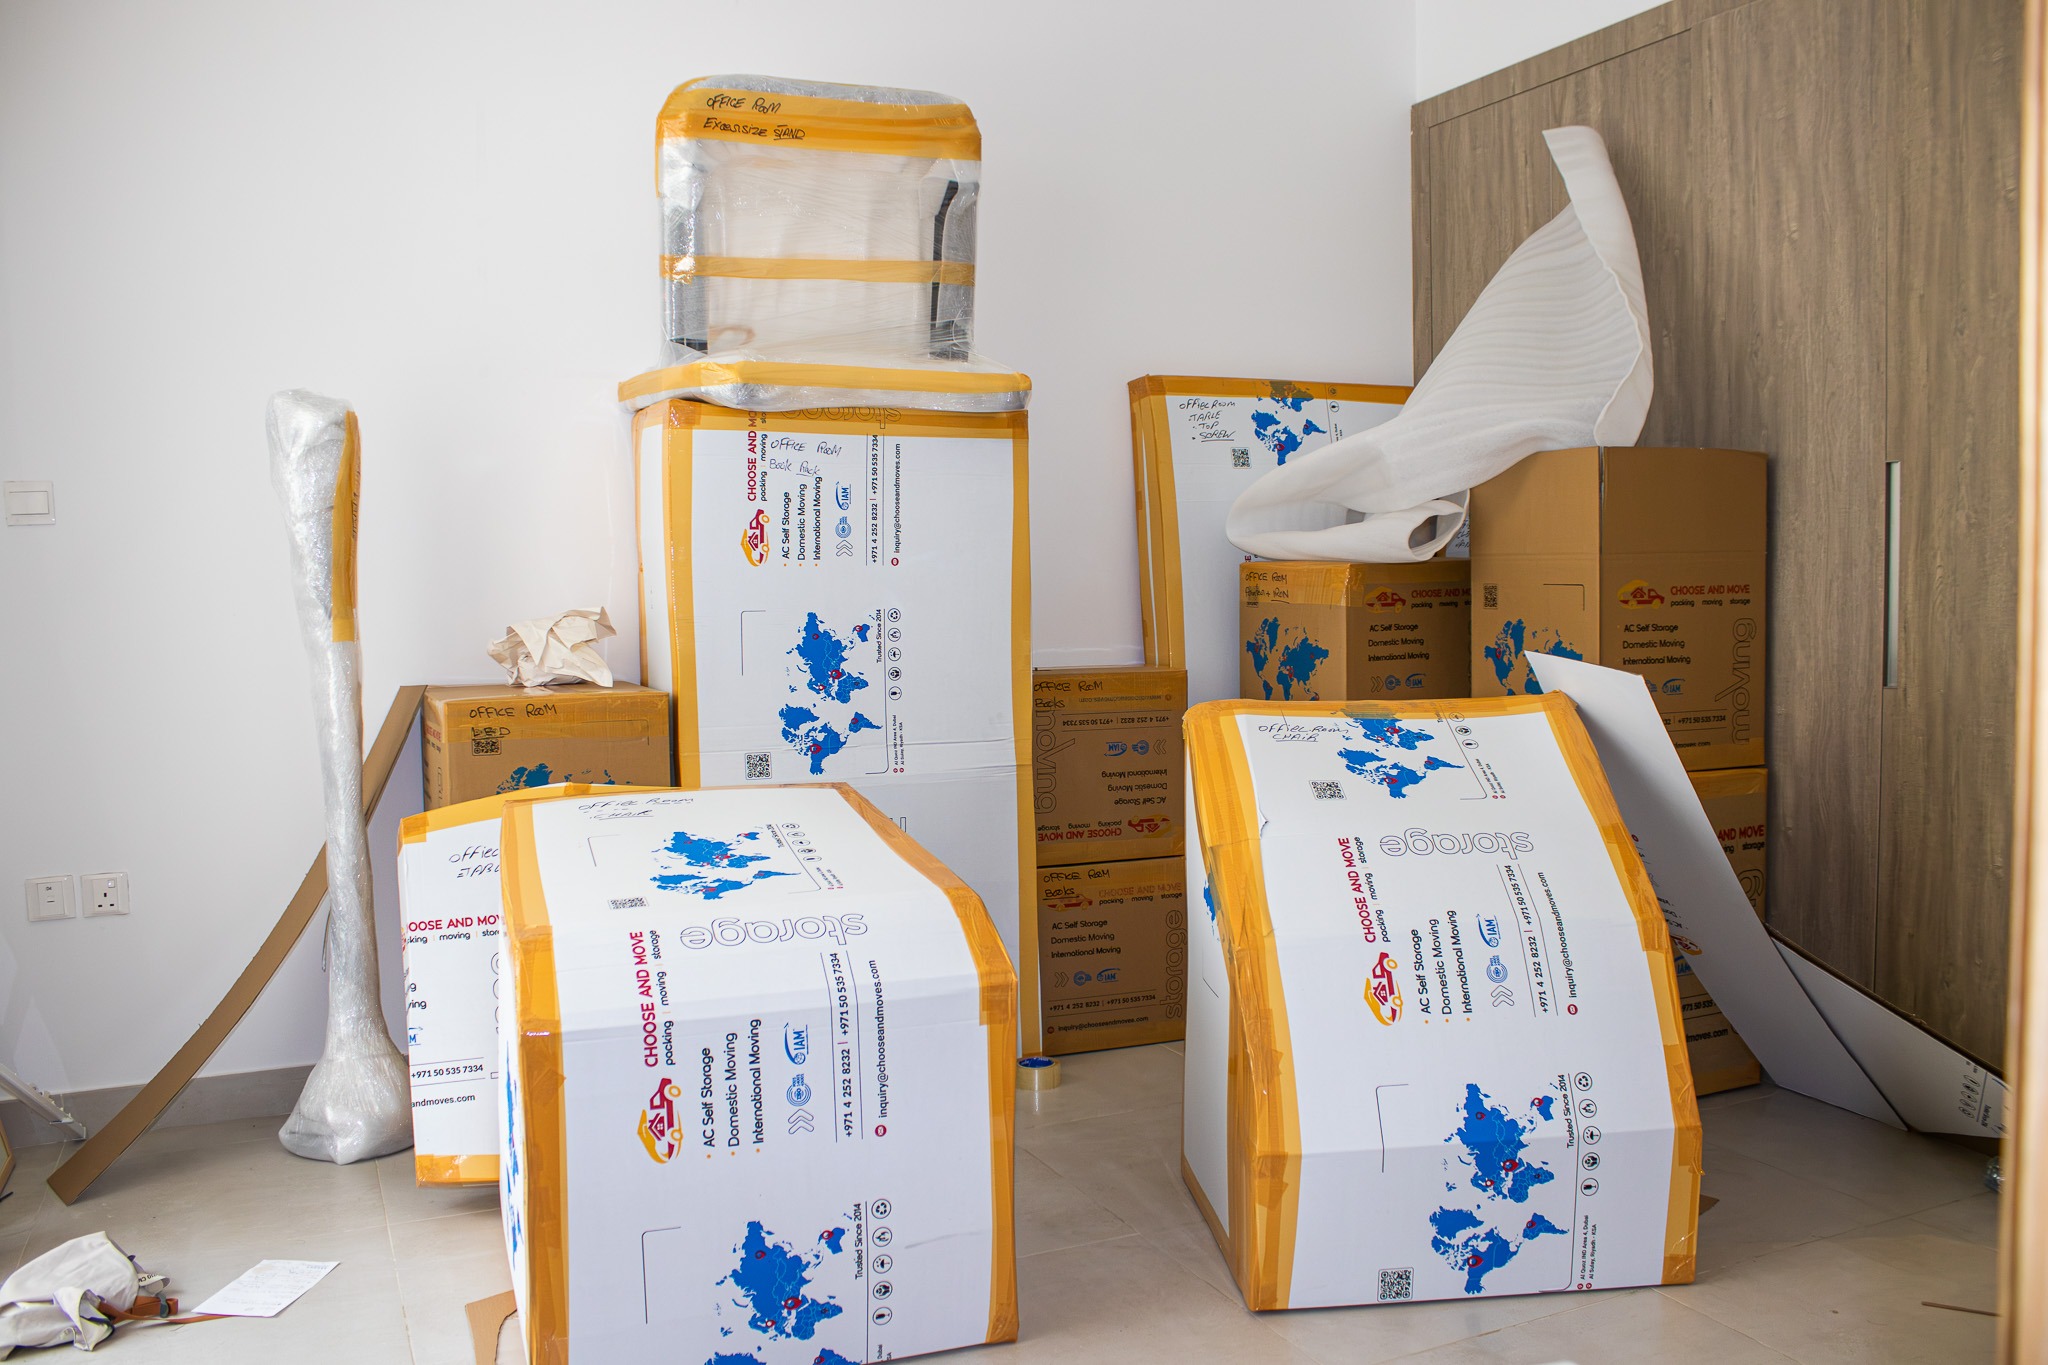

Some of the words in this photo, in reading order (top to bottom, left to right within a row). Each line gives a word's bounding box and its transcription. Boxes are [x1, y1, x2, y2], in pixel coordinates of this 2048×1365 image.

[706, 94, 746, 110] OFFICE
[752, 97, 781, 114] ROOM
[773, 124, 805, 140] STAND
[747, 430, 757, 454] AND
[760, 434, 768, 462] moving
[770, 437, 807, 452] OFFICE
[816, 441, 842, 457] ROOM
[747, 457, 757, 502] CHOOSE
[759, 471, 768, 502] packing
[797, 483, 807, 517] Moving
[813, 476, 823, 508] Moving
[841, 487, 849, 501] IAM
[893, 443, 901, 554] inquiry@chooseandmoves.com
[781, 491, 792, 526] Storage
[781, 527, 790, 543] Self
[797, 518, 806, 561] Domestic
[813, 508, 821, 561] International
[781, 545, 790, 560] AC
[1670, 585, 1705, 596] CHOOSE
[1707, 584, 1725, 595] AND
[1726, 583, 1750, 594] MOVE
[1670, 599, 1695, 608] packing
[1701, 598, 1723, 607] moving
[1729, 597, 1751, 606] storage
[1623, 624, 1636, 632] AC
[1637, 623, 1650, 632] Self
[1651, 623, 1679, 633] Storage
[1623, 640, 1657, 649] Domestic
[1660, 640, 1685, 649] Moving
[1622, 656, 1665, 665] International
[1666, 655, 1691, 665] Moving
[1033, 681, 1071, 692] OFFICE
[1078, 680, 1103, 692] ROOM
[1714, 617, 1756, 744] moving
[469, 705, 515, 719] OFFICE
[525, 703, 557, 718] ROOM
[1101, 770, 1126, 779] Moving
[1127, 768, 1167, 777] International
[1107, 784, 1133, 792] Moving
[1134, 782, 1167, 791] Domestic
[1114, 797, 1141, 806] Storage
[1142, 797, 1155, 805] Self
[1156, 796, 1167, 804] AC
[1066, 830, 1085, 840] AND
[1068, 822, 1091, 830] moving
[1087, 827, 1122, 838] CHOOSE
[1098, 820, 1122, 828] packing
[1718, 828, 1737, 841] AND
[1738, 825, 1765, 839] MOVE
[1037, 831, 1064, 841] MOVE
[1379, 827, 1534, 860] storage
[1338, 837, 1355, 868] MOVE
[1354, 836, 1367, 864] storage
[1043, 872, 1082, 883] OFFICE
[1347, 870, 1363, 894] AND
[1504, 864, 1517, 882] 7334
[1161, 892, 1183, 900] storage
[1365, 872, 1378, 901] moving
[1510, 882, 1522, 896] 535
[1516, 896, 1527, 907] 50
[446, 917, 473, 929] AND
[1354, 896, 1377, 943] CHOOSE
[1375, 909, 1391, 943] packing
[1486, 918, 1498, 936] IAM
[1520, 906, 1532, 926] +971
[439, 931, 471, 941] moving
[680, 913, 868, 949] storage
[1429, 918, 1443, 958] Moving
[1446, 910, 1462, 946] Moving
[1537, 872, 1577, 998] inquiry@chooseandmoves.com
[629, 931, 648, 966] MOVE
[650, 929, 662, 960] storage
[1411, 929, 1424, 971] Storage
[1528, 935, 1539, 958] 8232
[829, 952, 843, 975] 7334
[1160, 909, 1187, 1019] storage
[1533, 961, 1543, 978] 252
[636, 969, 653, 998] AND
[657, 971, 669, 1006] moving
[834, 975, 847, 993] 535
[1415, 974, 1428, 995] Self
[1434, 960, 1452, 1015] Domestic
[1452, 947, 1473, 1014] International
[838, 995, 848, 1008] 50
[1419, 997, 1432, 1014] AC
[1538, 990, 1548, 1014] +971
[839, 1009, 849, 1036] +971
[640, 1002, 658, 1068] CHOOSE
[662, 1020, 676, 1066] packing
[747, 1019, 761, 1065] Moving
[793, 1030, 805, 1051] IAM
[868, 959, 889, 1118] inquiry@chooseandmoves.com
[723, 1032, 738, 1081] Moving
[841, 1048, 851, 1075] 8232
[411, 1070, 432, 1079] +971
[433, 1068, 444, 1077] 50
[446, 1066, 461, 1076] 535
[463, 1064, 484, 1074] 7334
[700, 1047, 714, 1098] Storage
[1557, 1074, 1567, 1092] 2014
[842, 1078, 852, 1098] 252
[702, 1101, 714, 1125] Self
[726, 1084, 740, 1147] Domestic
[749, 1067, 764, 1144] International
[1562, 1093, 1571, 1117] Since
[843, 1111, 853, 1137] +971
[1565, 1118, 1575, 1149] Trusted
[702, 1128, 715, 1148] AC
[853, 1203, 862, 1222] 2014
[854, 1223, 863, 1248] Since
[854, 1249, 863, 1280] Trusted
